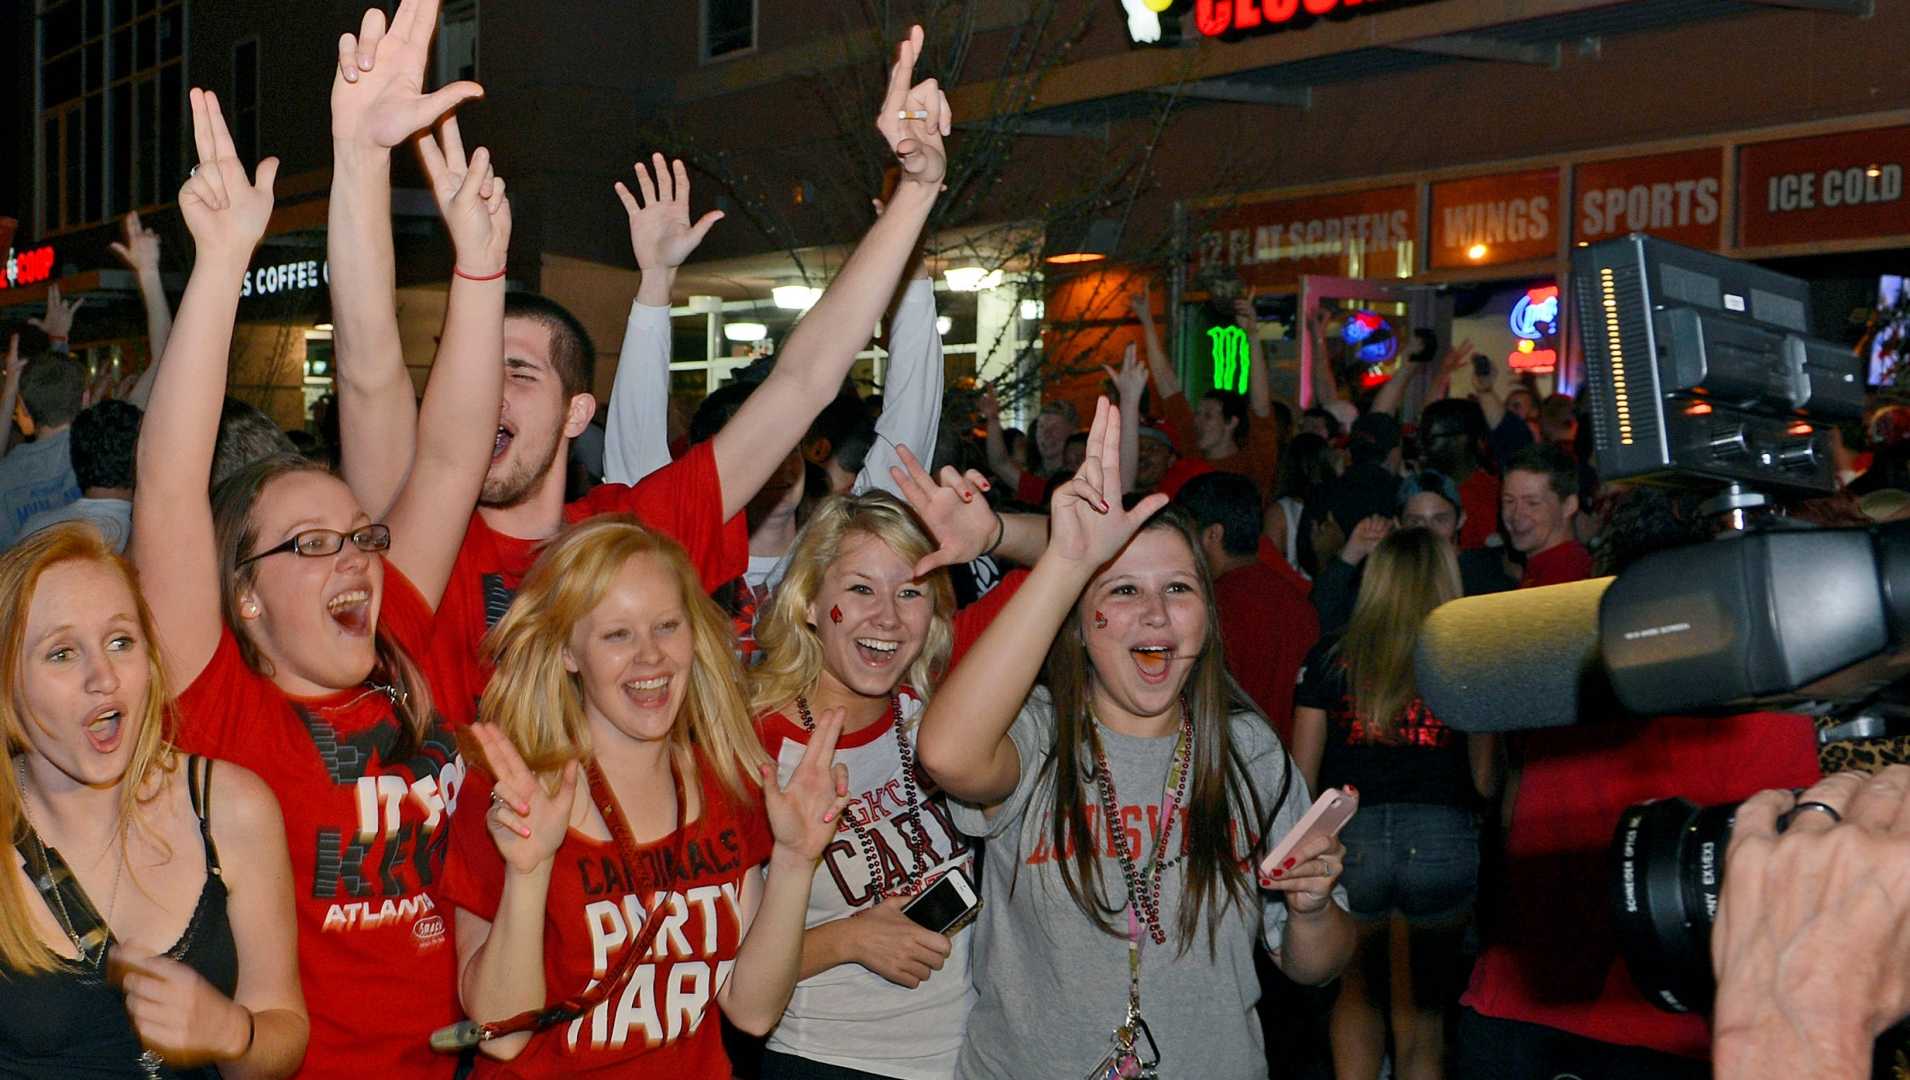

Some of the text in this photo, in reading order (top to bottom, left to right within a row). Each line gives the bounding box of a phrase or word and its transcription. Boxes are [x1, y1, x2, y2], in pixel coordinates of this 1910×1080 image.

[1583, 177, 1719, 236] SPORTS
[1767, 163, 1903, 213] ICE COLD
[1289, 209, 1408, 262] SCREENS
[1444, 196, 1549, 248] WINGS
[256, 260, 318, 294] COFFEE
[1623, 861, 1637, 912] SCHNEIDER
[1702, 842, 1715, 885] EX1/EX3
[322, 892, 435, 925] ATLANA
